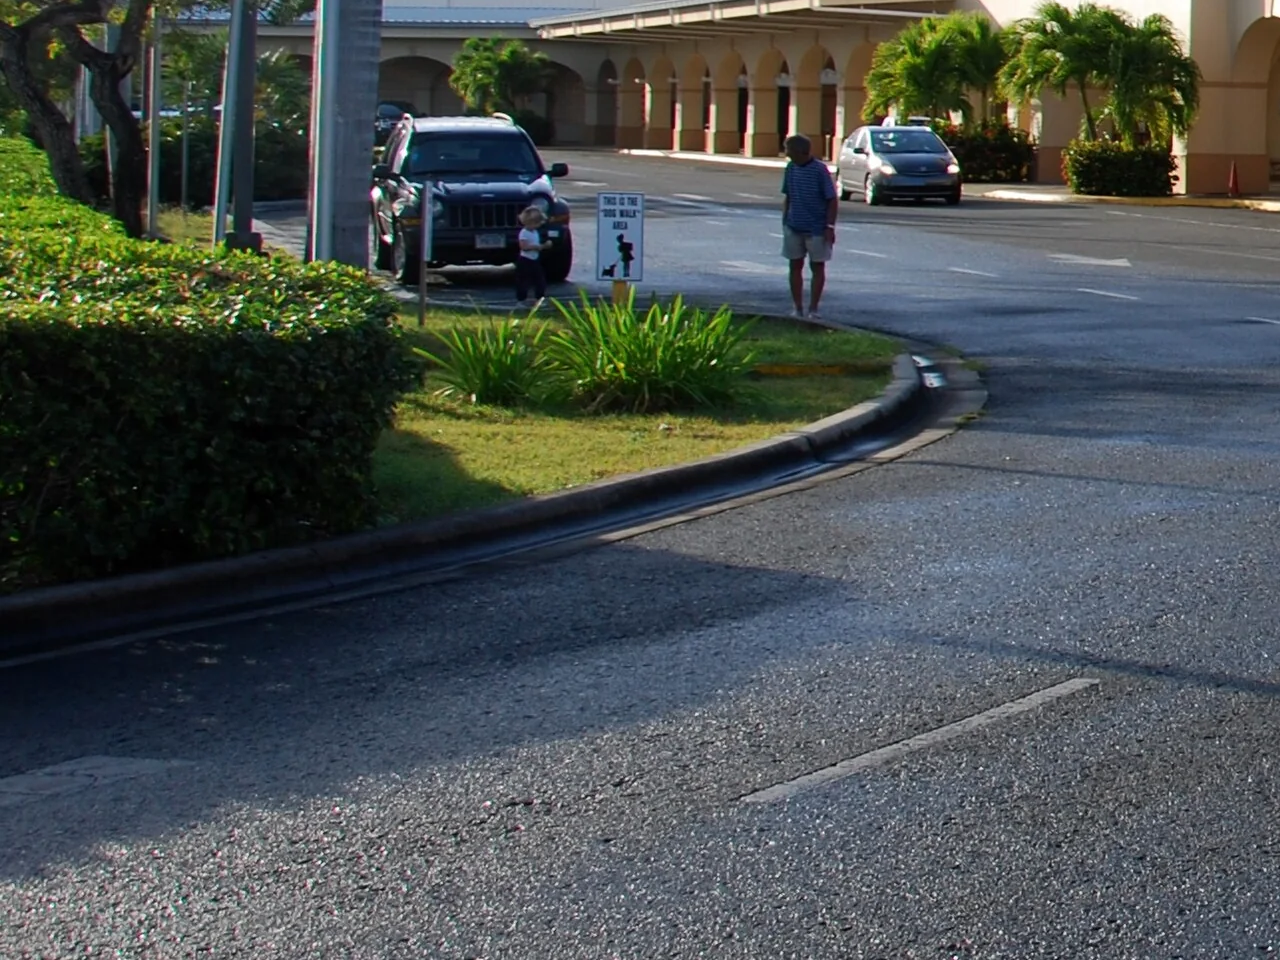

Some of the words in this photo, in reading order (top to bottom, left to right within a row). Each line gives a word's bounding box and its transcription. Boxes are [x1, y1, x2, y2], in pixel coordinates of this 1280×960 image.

[603, 196, 617, 206] THIS
[619, 196, 625, 206] IS
[627, 196, 638, 206] THE
[612, 220, 628, 230] AREA
